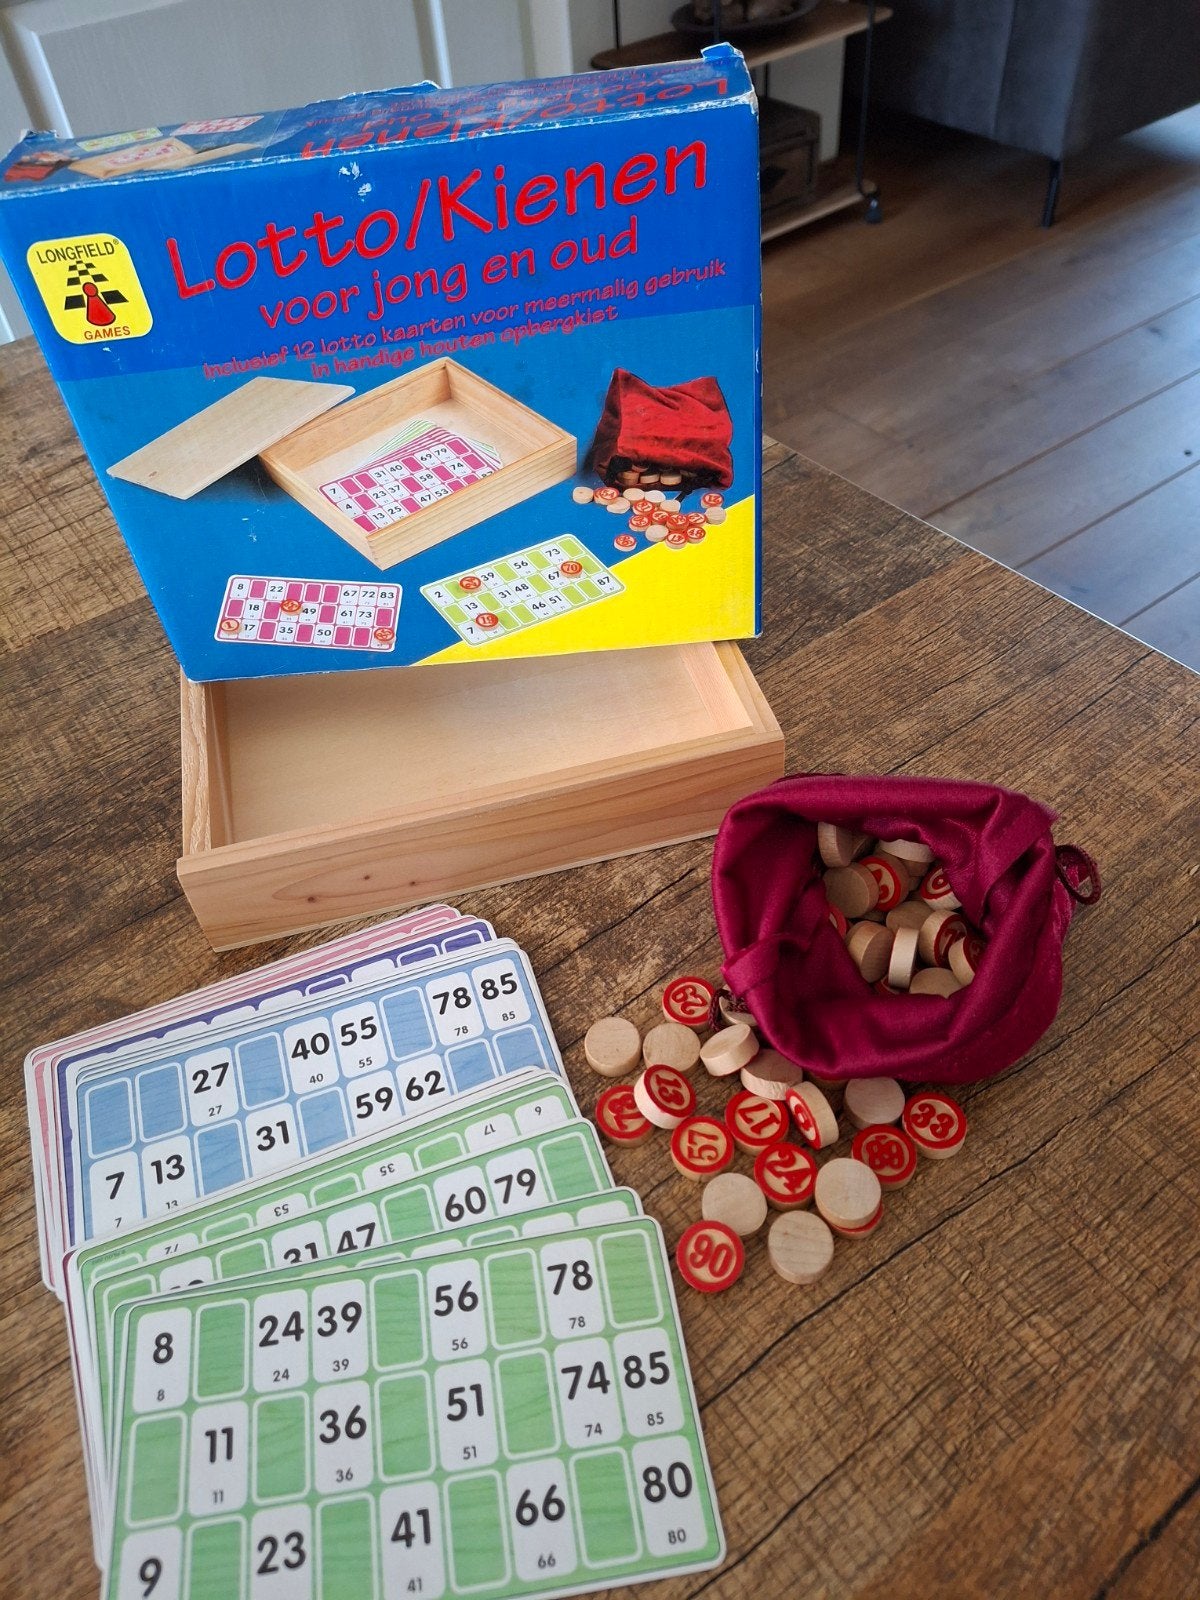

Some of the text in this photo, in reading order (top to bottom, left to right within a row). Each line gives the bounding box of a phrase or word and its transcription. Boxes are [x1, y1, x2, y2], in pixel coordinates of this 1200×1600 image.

[166, 140, 707, 299] Lotto/Kienen
[260, 215, 638, 328] voor jong en oud
[293, 340, 316, 360] 12
[320, 332, 376, 355] lotto
[380, 315, 466, 343] kaarten
[472, 302, 519, 325] voor
[524, 278, 639, 315] meermalig
[644, 258, 726, 294] gebruik
[84, 325, 131, 341] GAMES
[333, 343, 415, 368] handige
[420, 327, 496, 358] houten
[500, 304, 618, 345] opbergkist
[192, 972, 518, 1094] 27 40 55 78 85
[207, 1010, 516, 1118] 27 40 55 78 85
[654, 1072, 685, 1106] 13
[736, 1101, 780, 1137] 17
[910, 1102, 955, 1141] 33
[105, 1070, 446, 1200] 7 13 31 59 62
[686, 1128, 719, 1163] 57
[764, 1148, 812, 1194] 24
[113, 1216, 123, 1230] 7
[336, 1221, 377, 1254] 47
[444, 1186, 487, 1223] 60
[494, 1168, 536, 1205] 79
[688, 1234, 733, 1278] 90
[152, 1259, 593, 1365] 8 24 39 56 78
[156, 1315, 586, 1402] 8 24 39 56 78
[204, 1350, 670, 1464] 11 36 51 74 85
[212, 1411, 665, 1504] 11 36 51 74 85
[139, 1461, 693, 1598] 9 23 41 66 80
[407, 1528, 687, 1593] 41 66 80
